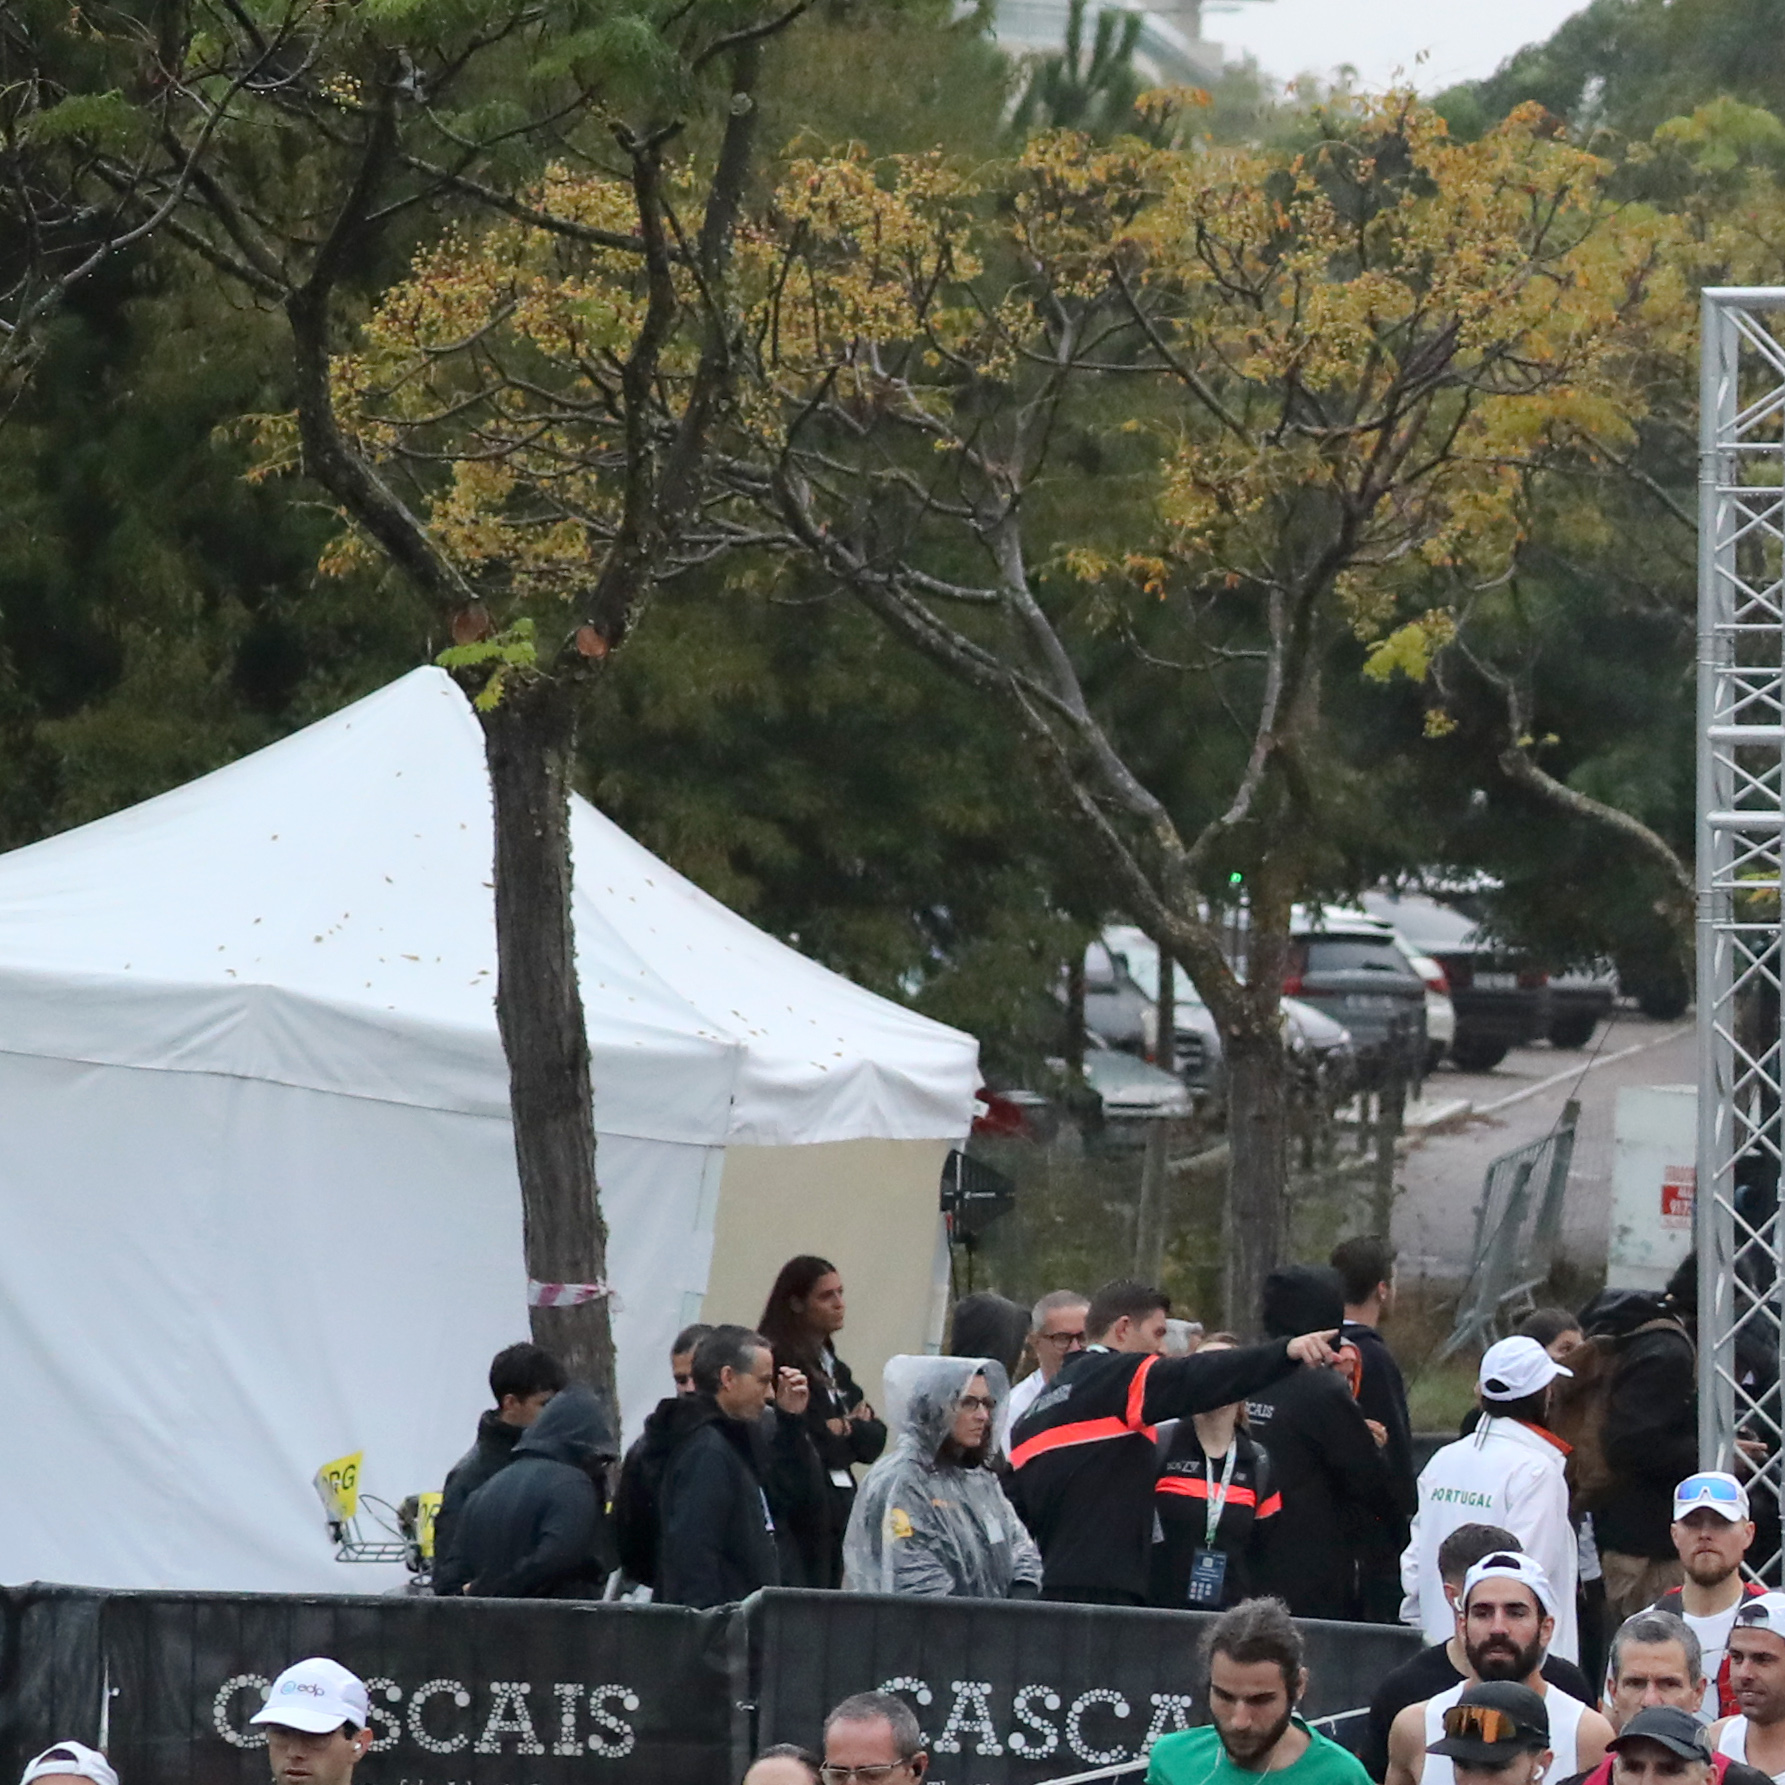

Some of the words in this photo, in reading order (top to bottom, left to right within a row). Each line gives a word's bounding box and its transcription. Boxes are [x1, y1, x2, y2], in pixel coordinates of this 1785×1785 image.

[1431, 1487, 1493, 1508] PORTUGAL
[296, 1683, 325, 1698] edp
[213, 1673, 640, 1759] CSCAIS
